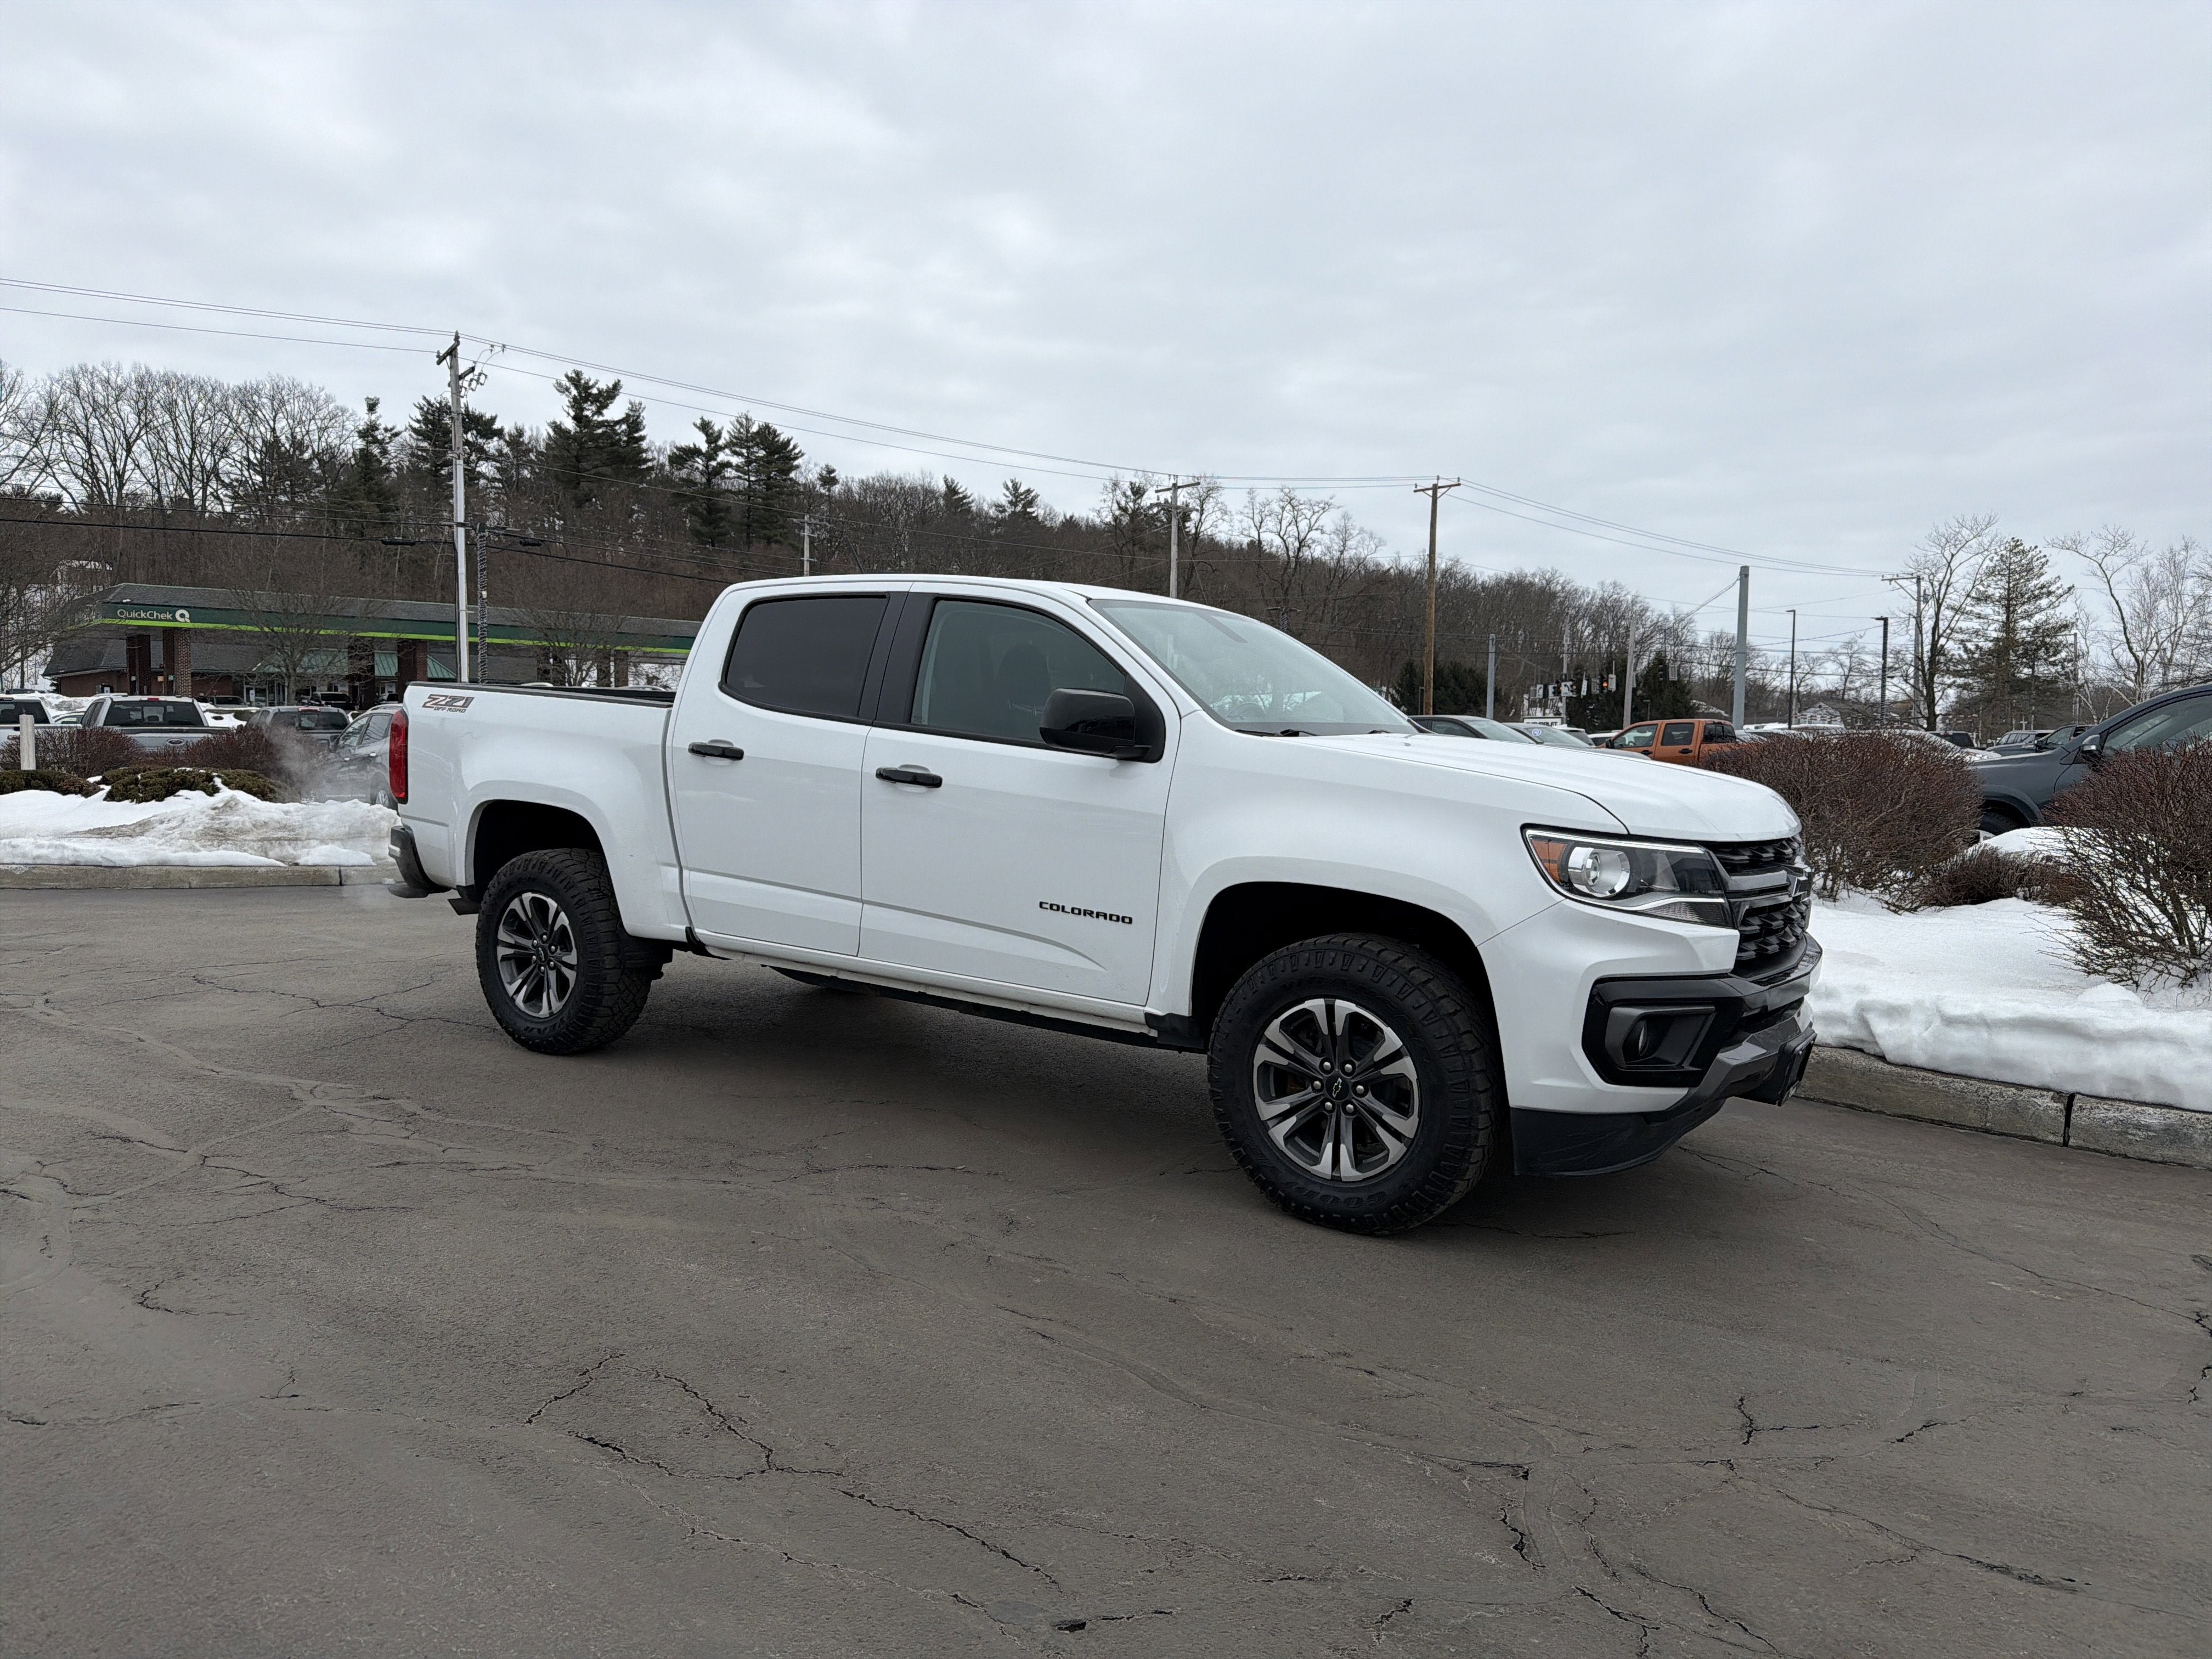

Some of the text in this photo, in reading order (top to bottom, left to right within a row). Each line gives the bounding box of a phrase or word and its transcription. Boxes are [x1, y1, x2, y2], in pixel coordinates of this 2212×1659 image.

[117, 609, 173, 620] QuickChek
[421, 693, 475, 709] Z71
[1039, 901, 1133, 924] COLORADO
